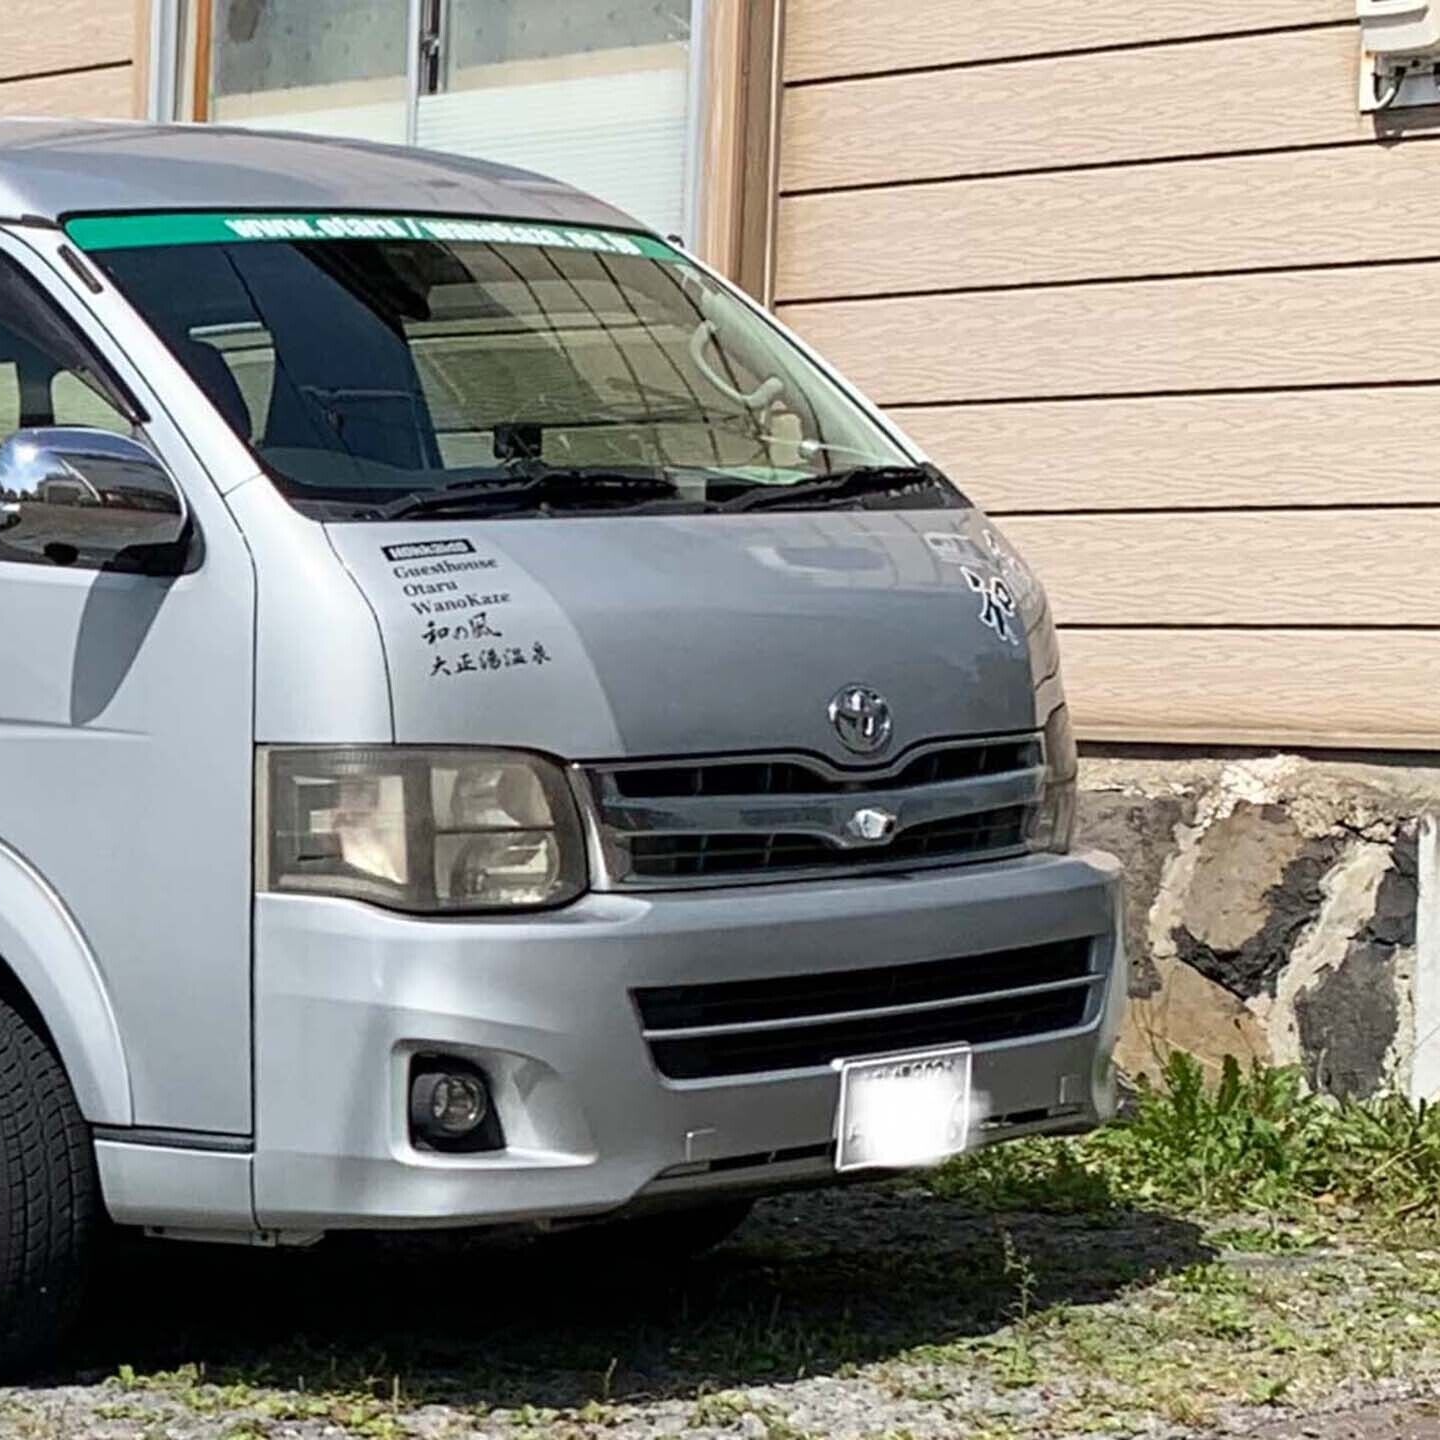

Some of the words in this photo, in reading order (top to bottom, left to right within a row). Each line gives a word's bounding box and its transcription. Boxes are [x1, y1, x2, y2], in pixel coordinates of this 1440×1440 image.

[393, 558, 498, 579] Guesthouse
[403, 580, 458, 598] Otaru
[411, 592, 511, 615] WanoKaze
[422, 611, 503, 645] 和の風
